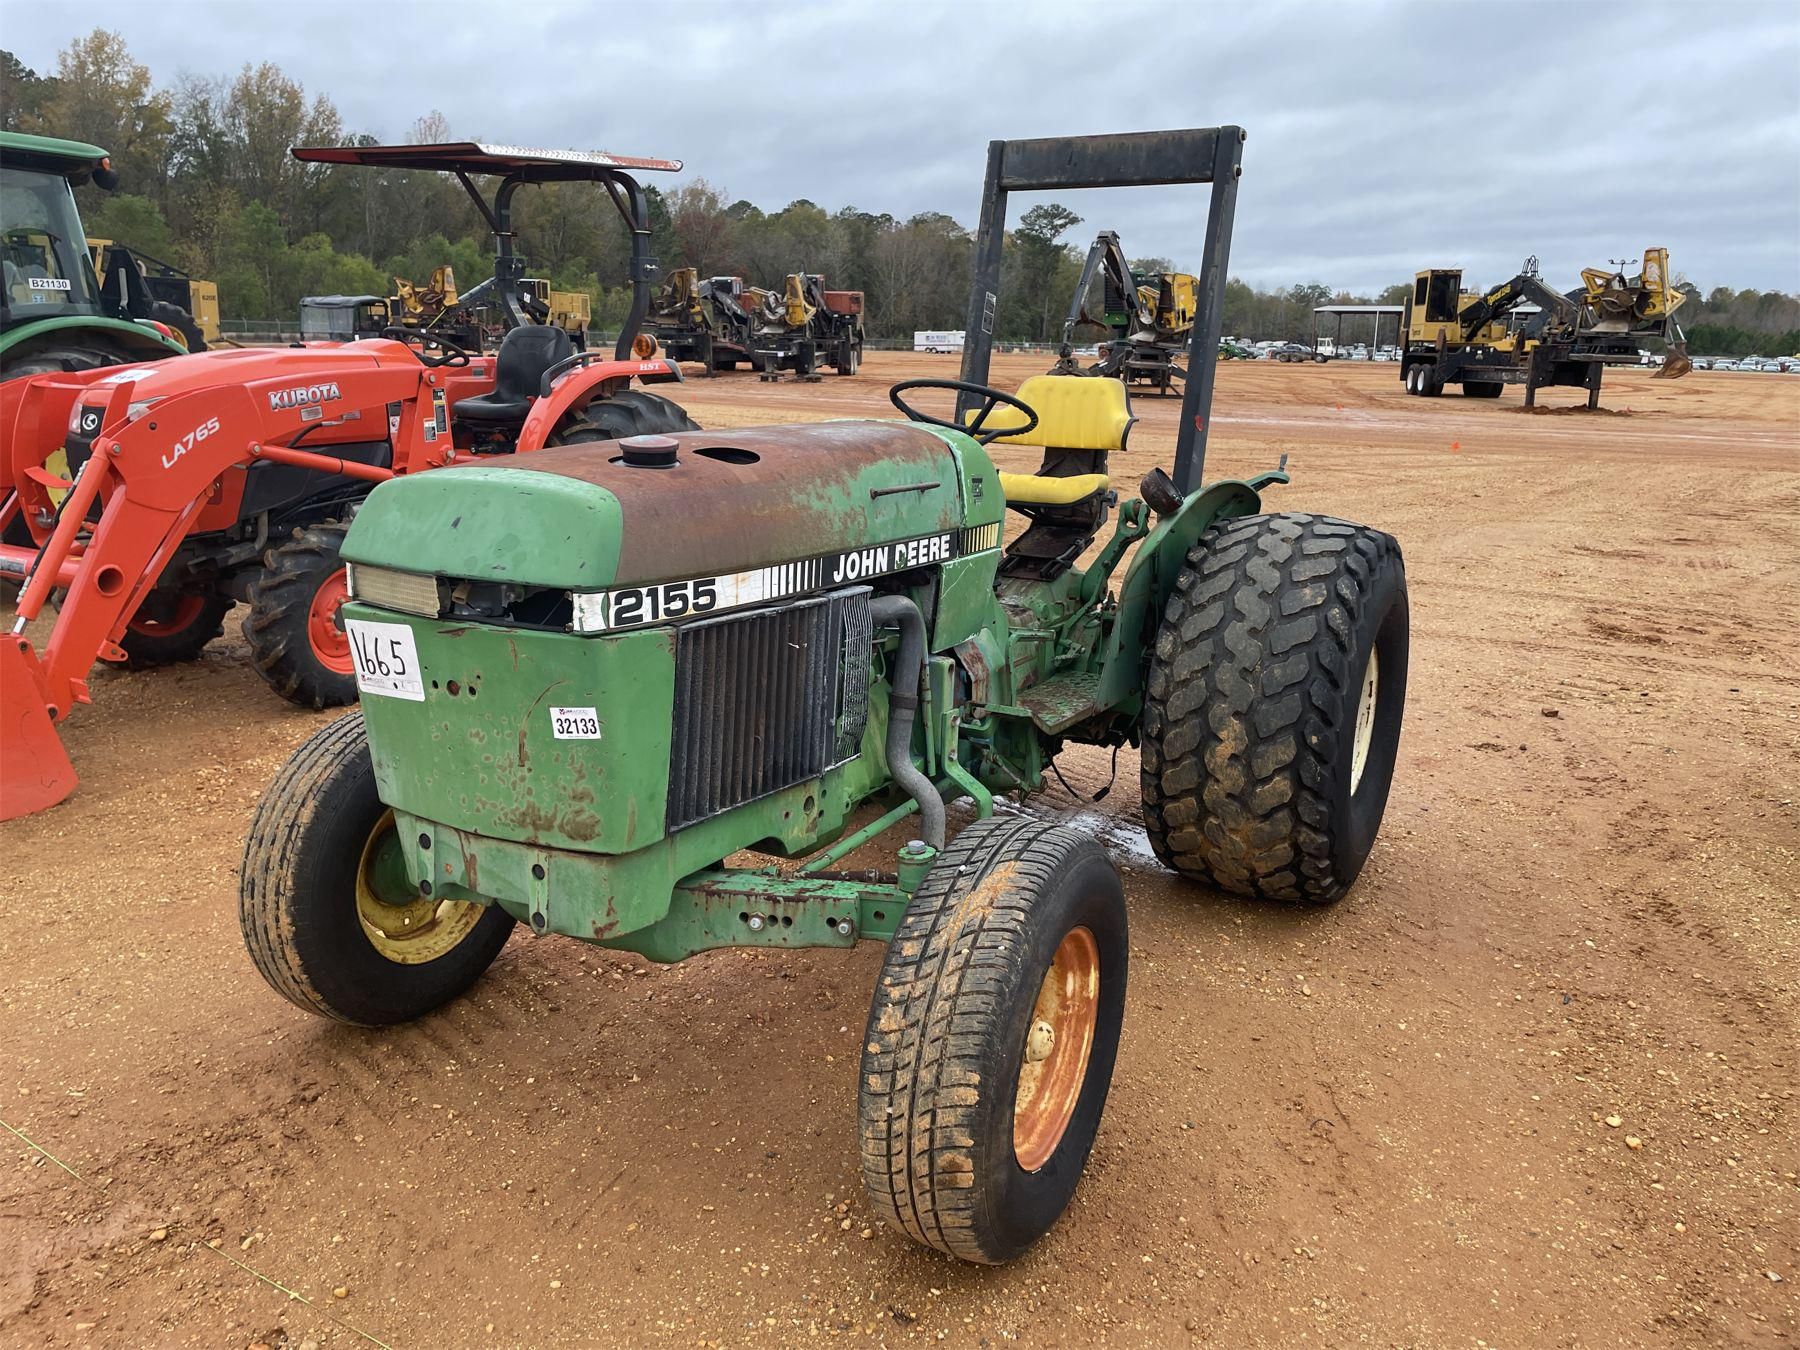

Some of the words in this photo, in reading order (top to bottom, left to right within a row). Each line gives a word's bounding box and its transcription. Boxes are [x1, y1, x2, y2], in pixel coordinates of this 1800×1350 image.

[32, 279, 68, 289] B21130
[640, 363, 660, 371] HST
[267, 382, 342, 411] KUBOTA
[161, 416, 221, 469] LA765
[833, 546, 889, 583] JOHN
[894, 534, 951, 570] DEERE
[613, 578, 717, 627] 2155
[350, 628, 406, 677] 1665
[556, 717, 598, 735] 32133
